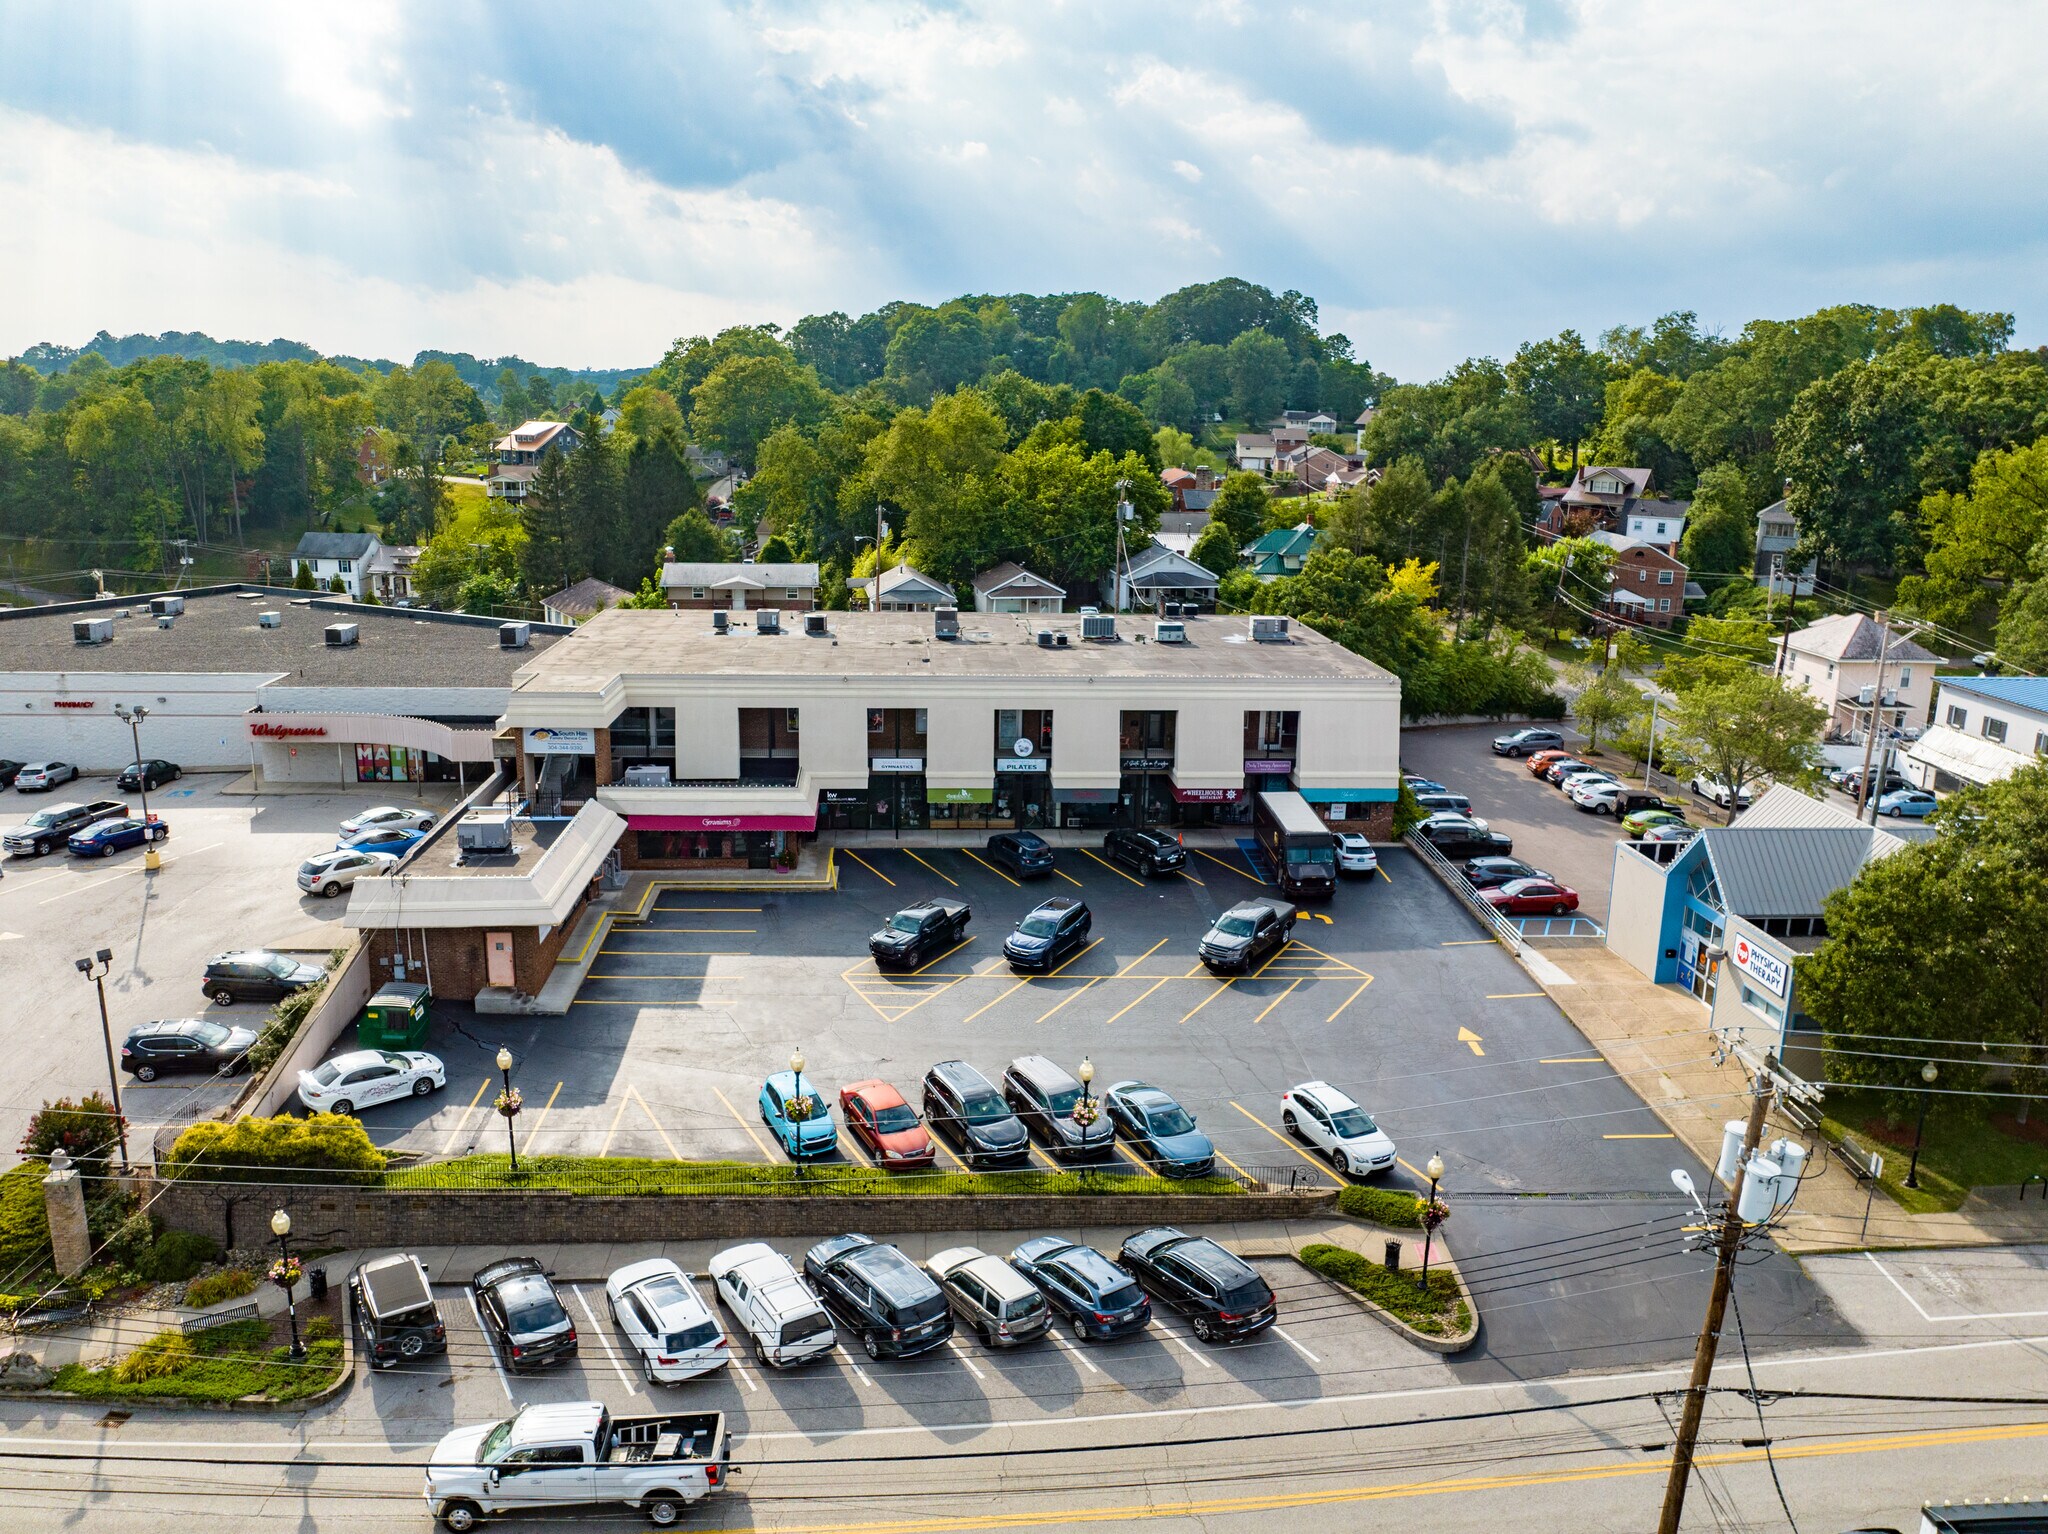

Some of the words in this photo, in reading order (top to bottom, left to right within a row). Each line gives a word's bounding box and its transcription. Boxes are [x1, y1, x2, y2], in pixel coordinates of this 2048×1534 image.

[53, 701, 95, 709] PHARMACY
[249, 722, 328, 740] Walgreens
[827, 790, 838, 799] kw
[1750, 948, 1782, 978] PHYSICAL
[1749, 960, 1781, 989] THERAPY
